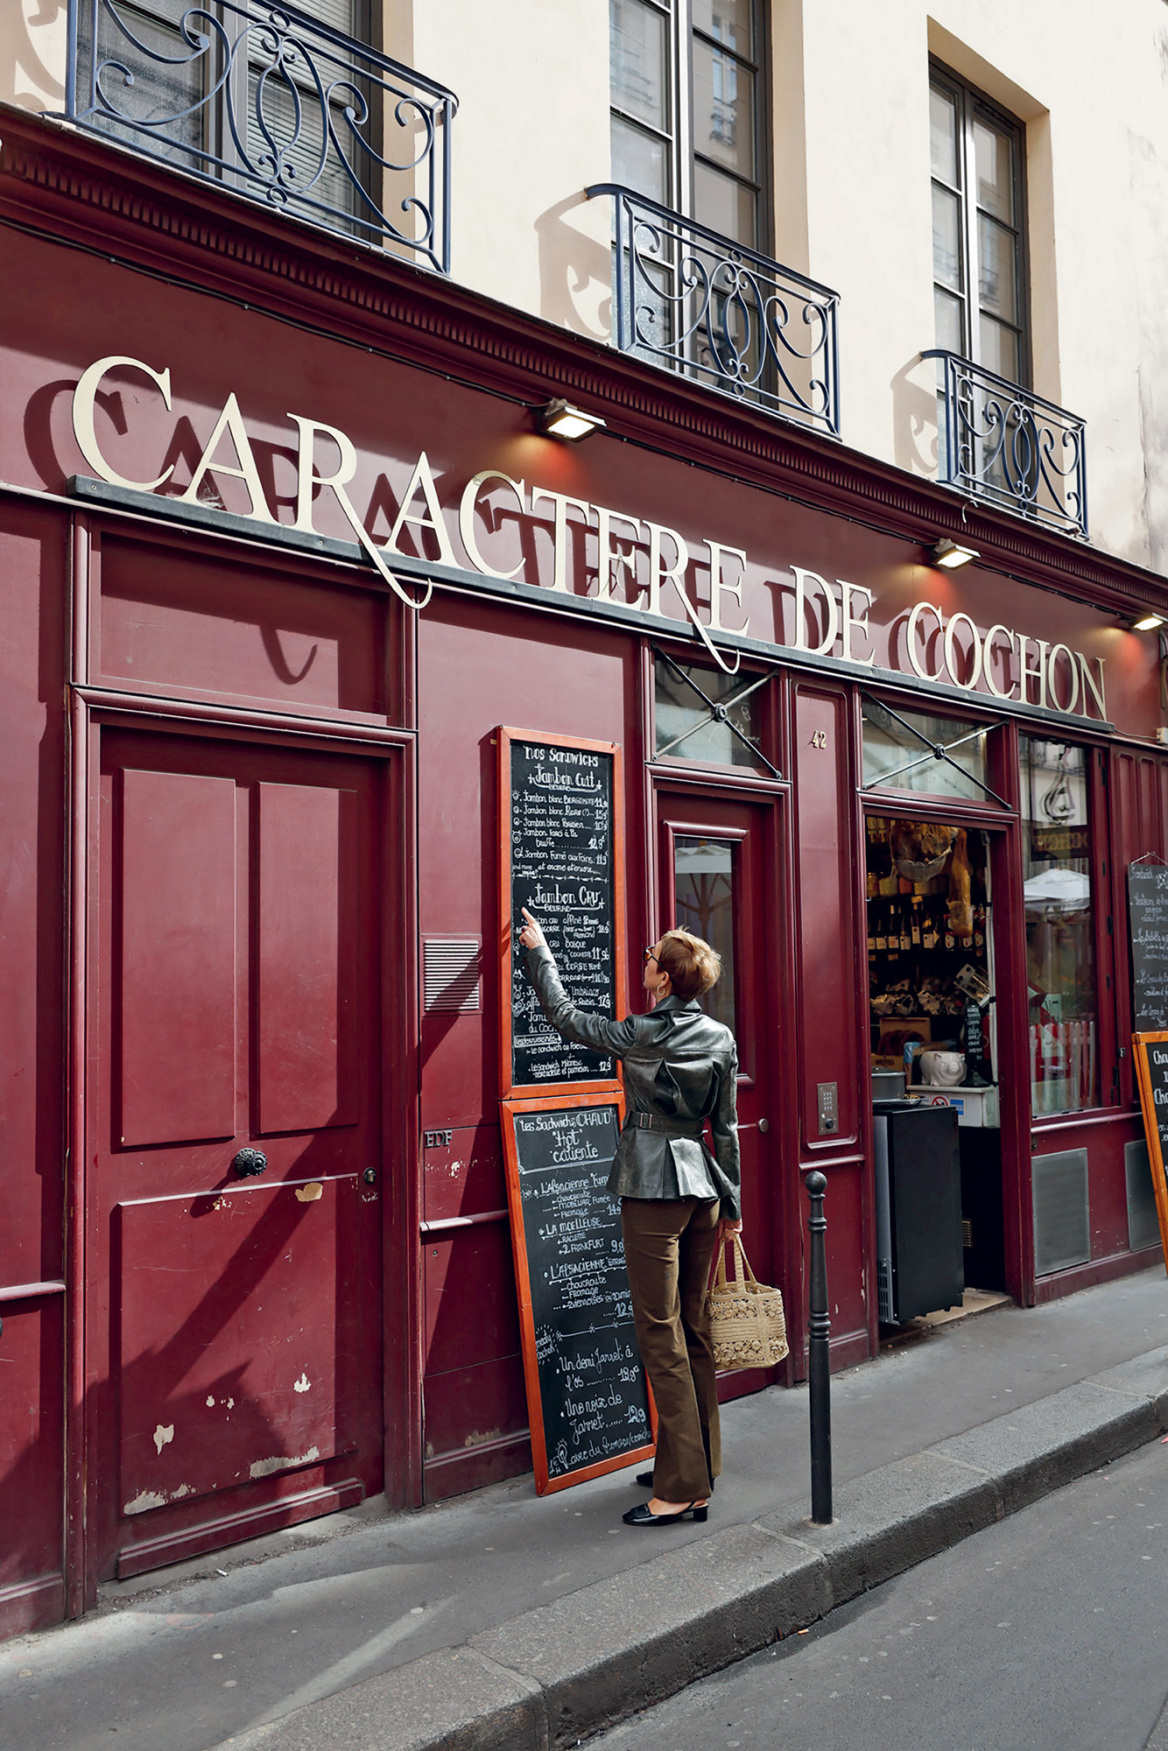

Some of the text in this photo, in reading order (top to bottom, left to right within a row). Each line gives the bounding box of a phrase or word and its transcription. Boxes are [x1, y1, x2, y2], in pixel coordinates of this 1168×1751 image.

[73, 356, 1107, 722] CARACTERE DE COCHON
[812, 730, 826, 749] 42
[535, 883, 576, 904] Jambon
[425, 1130, 452, 1148] EDF
